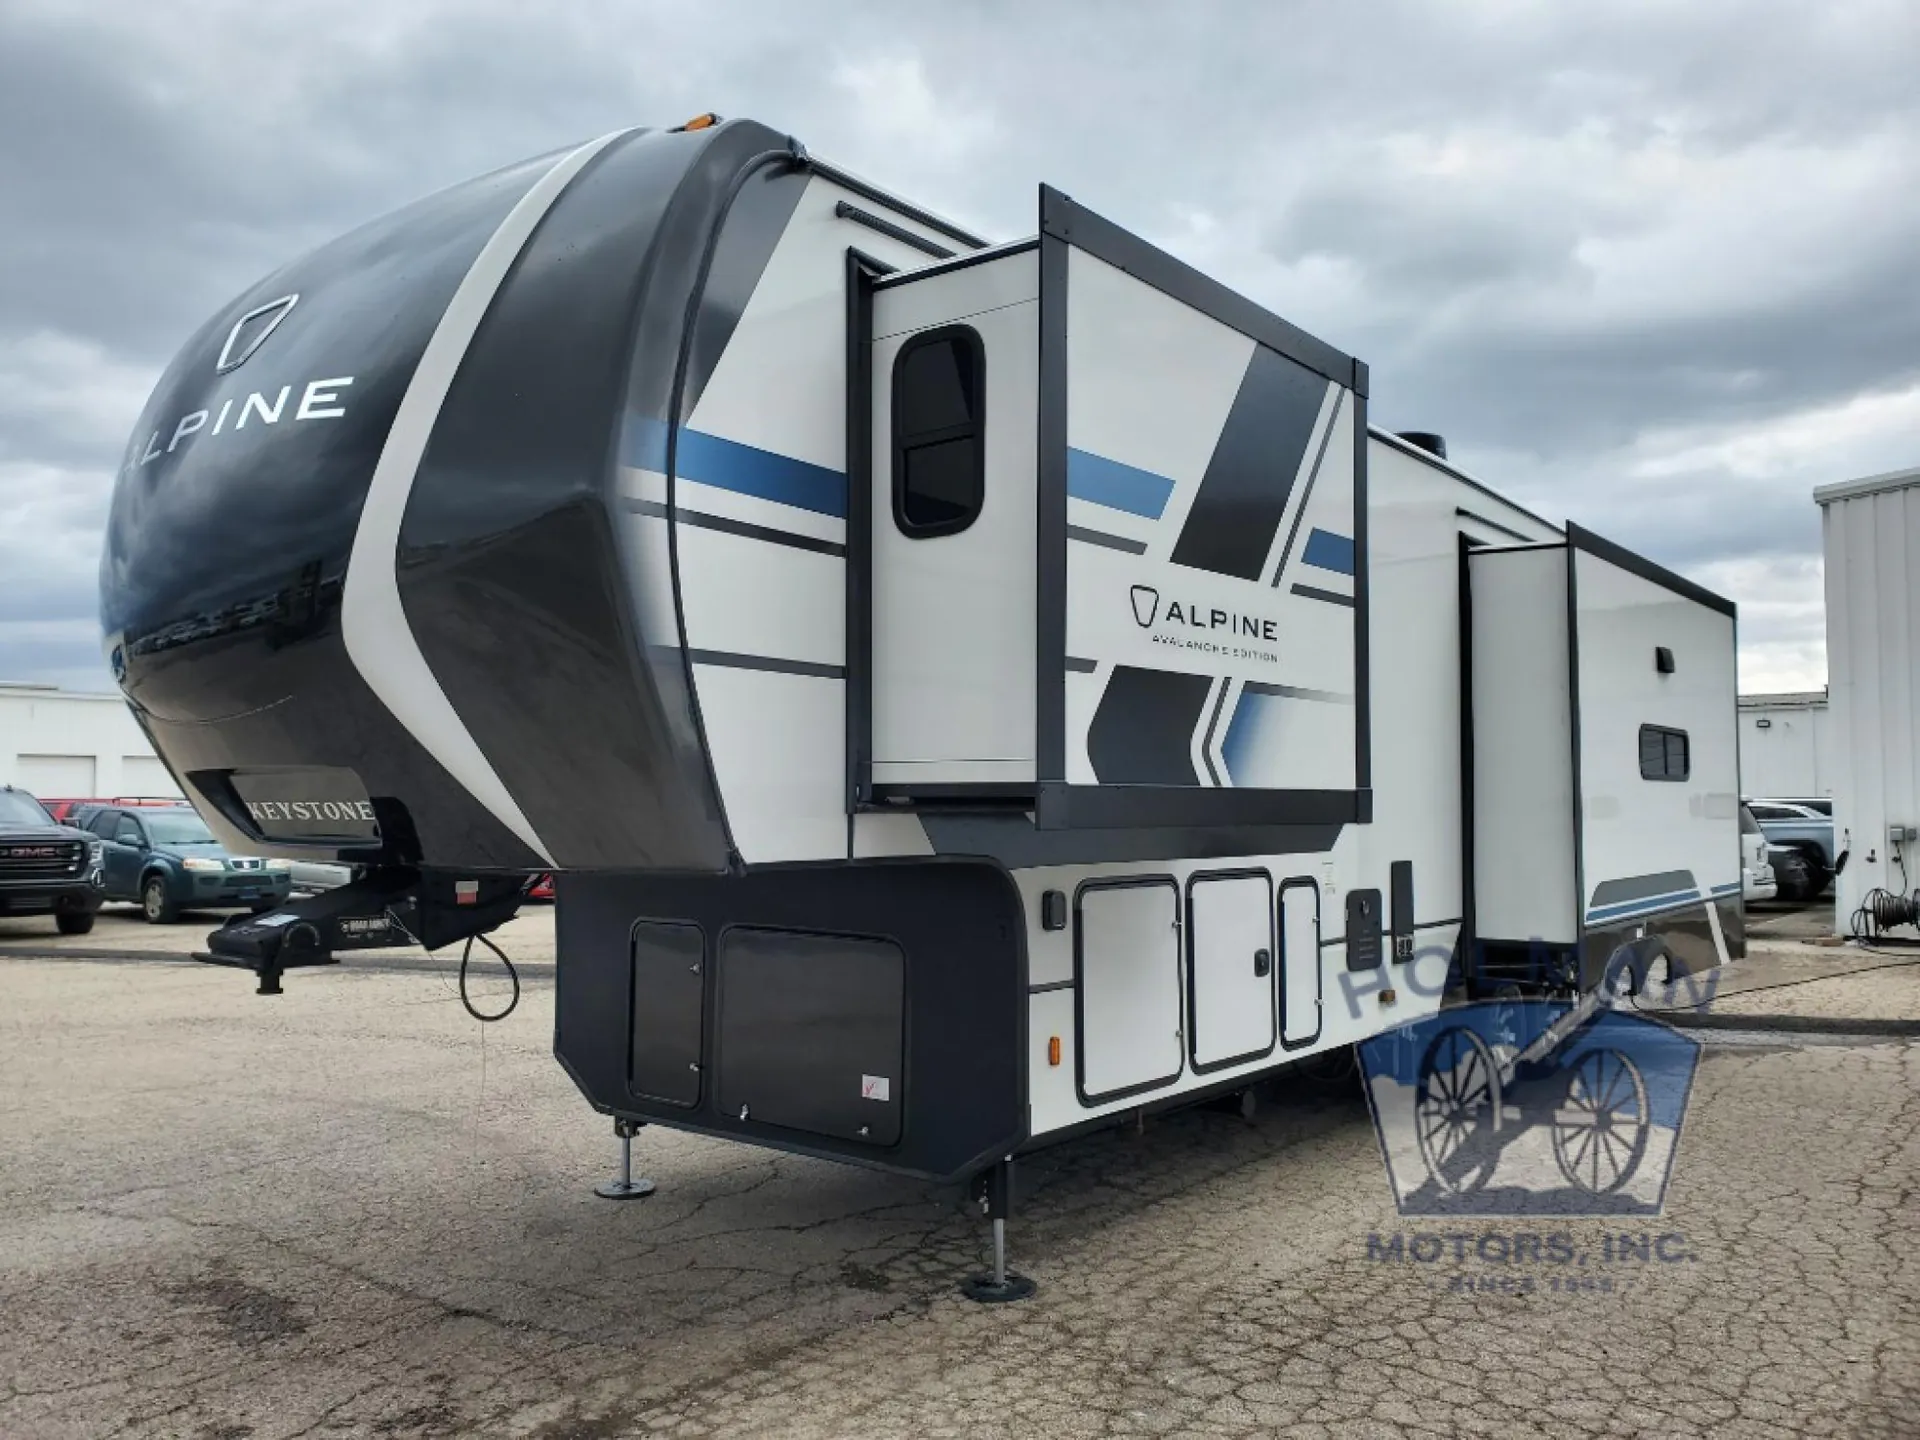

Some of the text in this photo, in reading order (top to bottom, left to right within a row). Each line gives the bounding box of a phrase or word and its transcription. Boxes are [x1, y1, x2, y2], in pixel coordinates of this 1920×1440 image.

[124, 376, 354, 471] ALPINE
[1166, 601, 1278, 642] ALPINE
[1152, 634, 1278, 663] AVALANCHE EDITION
[246, 801, 376, 821] KEYSTONE
[10, 846, 56, 858] GMC
